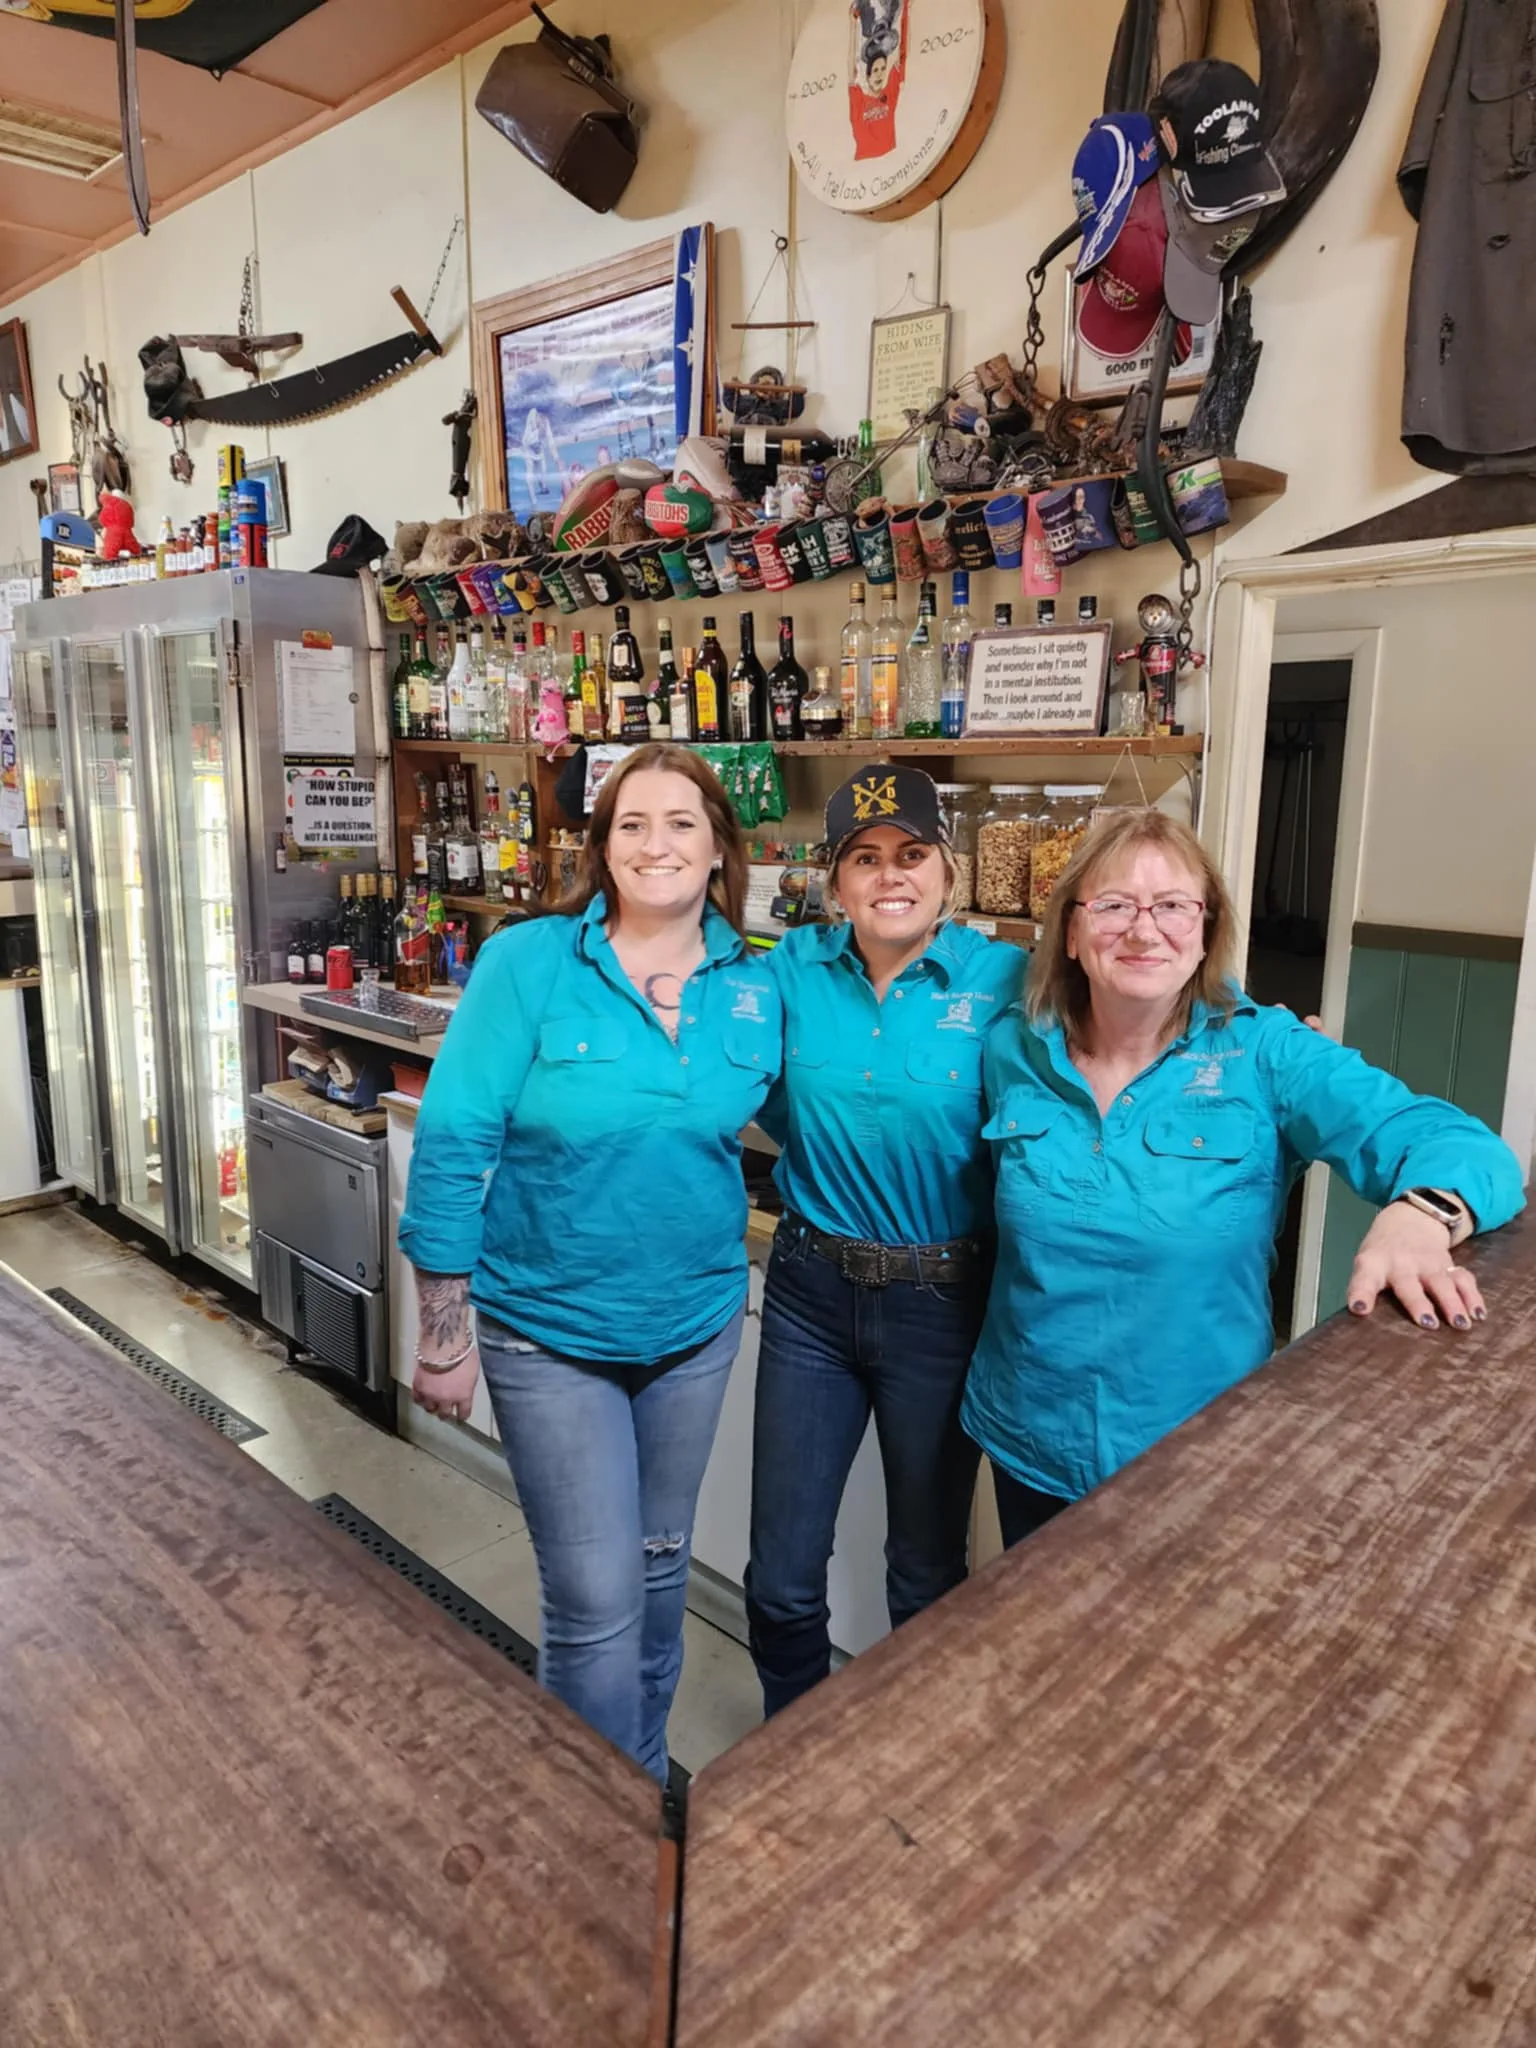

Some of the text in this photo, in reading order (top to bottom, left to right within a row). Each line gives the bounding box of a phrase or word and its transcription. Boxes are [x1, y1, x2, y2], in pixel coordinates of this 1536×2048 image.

[920, 28, 966, 53] 2002
[801, 73, 837, 98] 2002
[804, 136, 934, 200] All Ireland Champions
[887, 320, 933, 338] HIDING
[877, 340, 909, 357] FROM
[914, 334, 942, 349] WIFE
[1105, 361, 1137, 376] GOOD
[987, 644, 1037, 657] Sometimes
[1043, 642, 1055, 654] sit
[1056, 641, 1088, 656] quietly
[984, 657, 1088, 673] and wonder why I'm not
[984, 678, 993, 688] in
[1001, 676, 1033, 688] mental
[983, 693, 1004, 705] Then
[1010, 692, 1029, 704] look
[1030, 691, 1063, 703] around
[1064, 691, 1082, 702] and
[1042, 707, 1075, 721] already
[1077, 708, 1092, 718] am
[338, 781, 375, 793] STUPID
[867, 776, 877, 789] T
[305, 794, 327, 806] CAN
[329, 795, 350, 807] YOU
[304, 832, 321, 843] NOT
